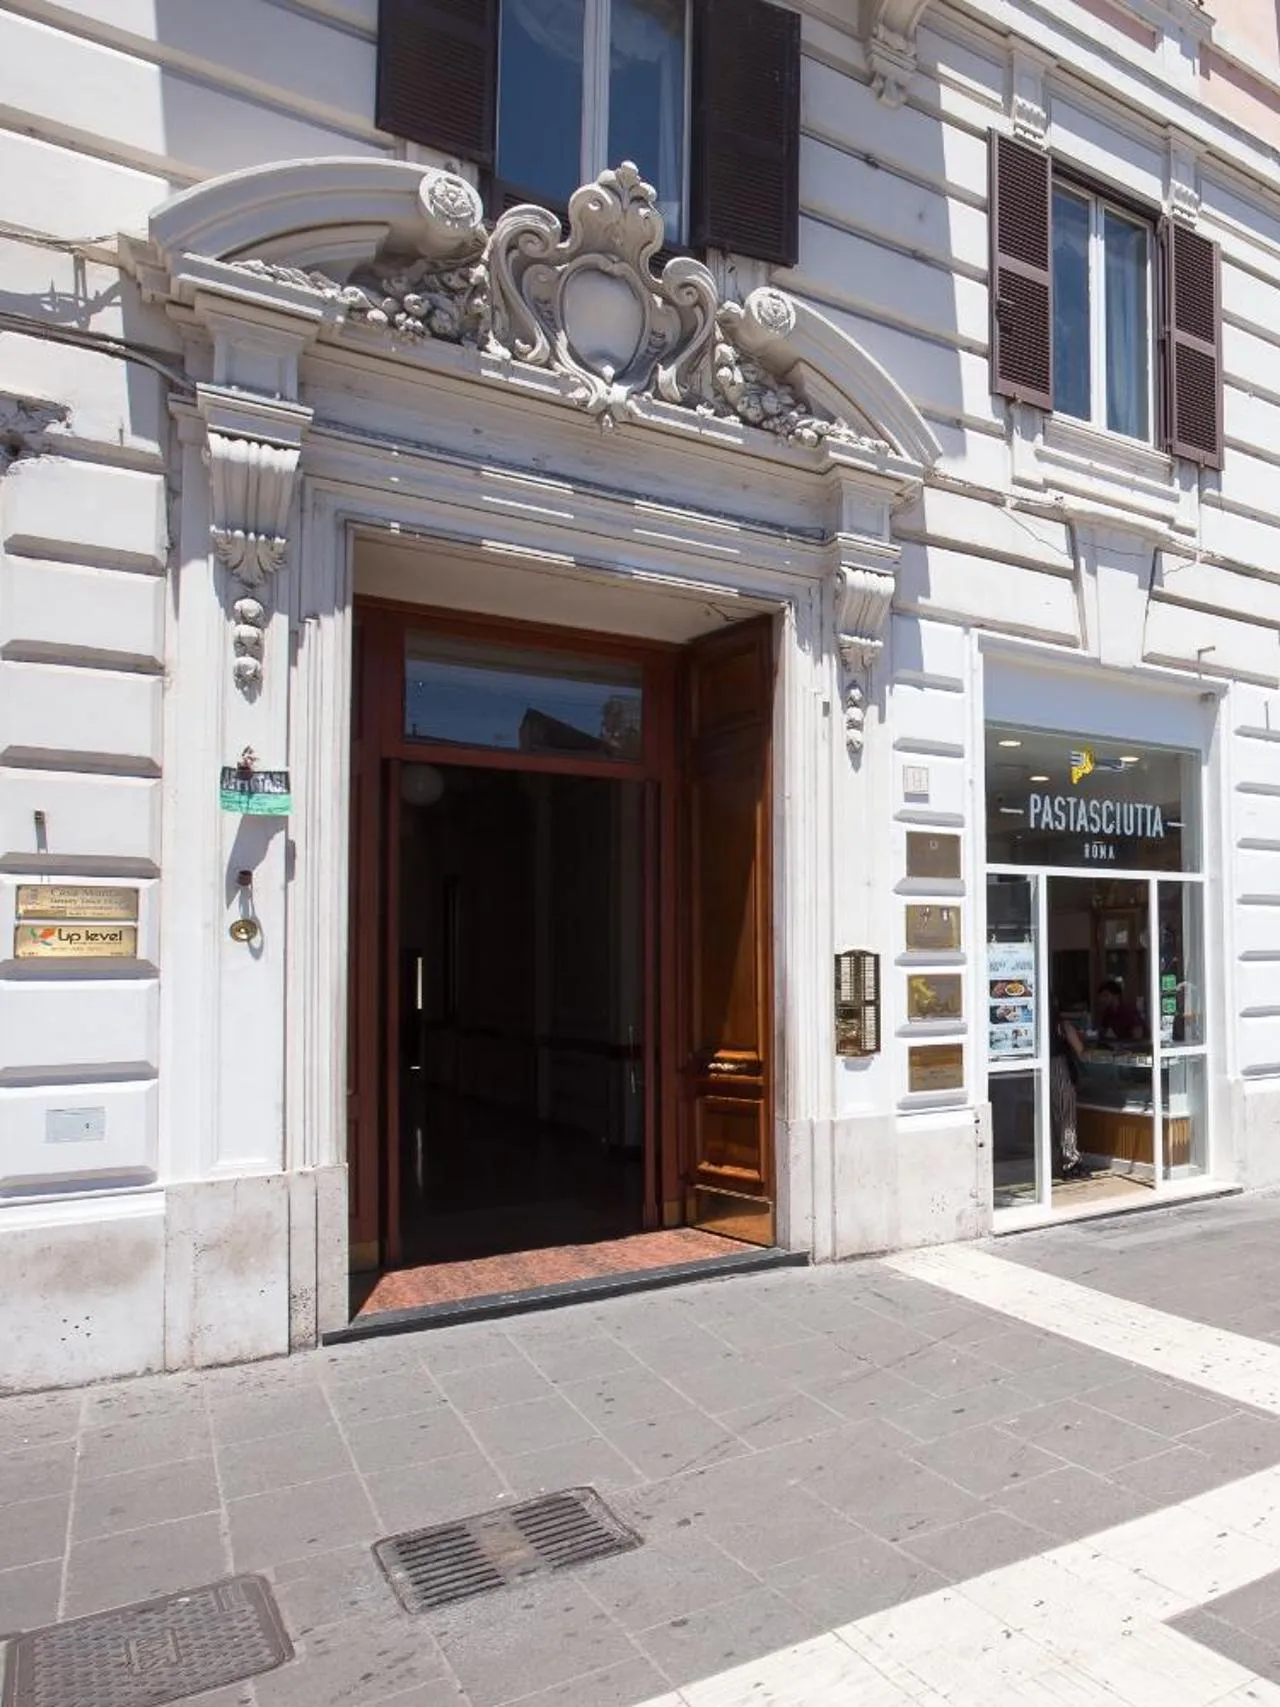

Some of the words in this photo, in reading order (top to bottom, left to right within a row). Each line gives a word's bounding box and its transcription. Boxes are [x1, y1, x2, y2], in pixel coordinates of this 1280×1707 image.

[1029, 793, 1164, 838] PASTASCIUTTA
[58, 928, 82, 944] Up
[85, 930, 123, 941] level
